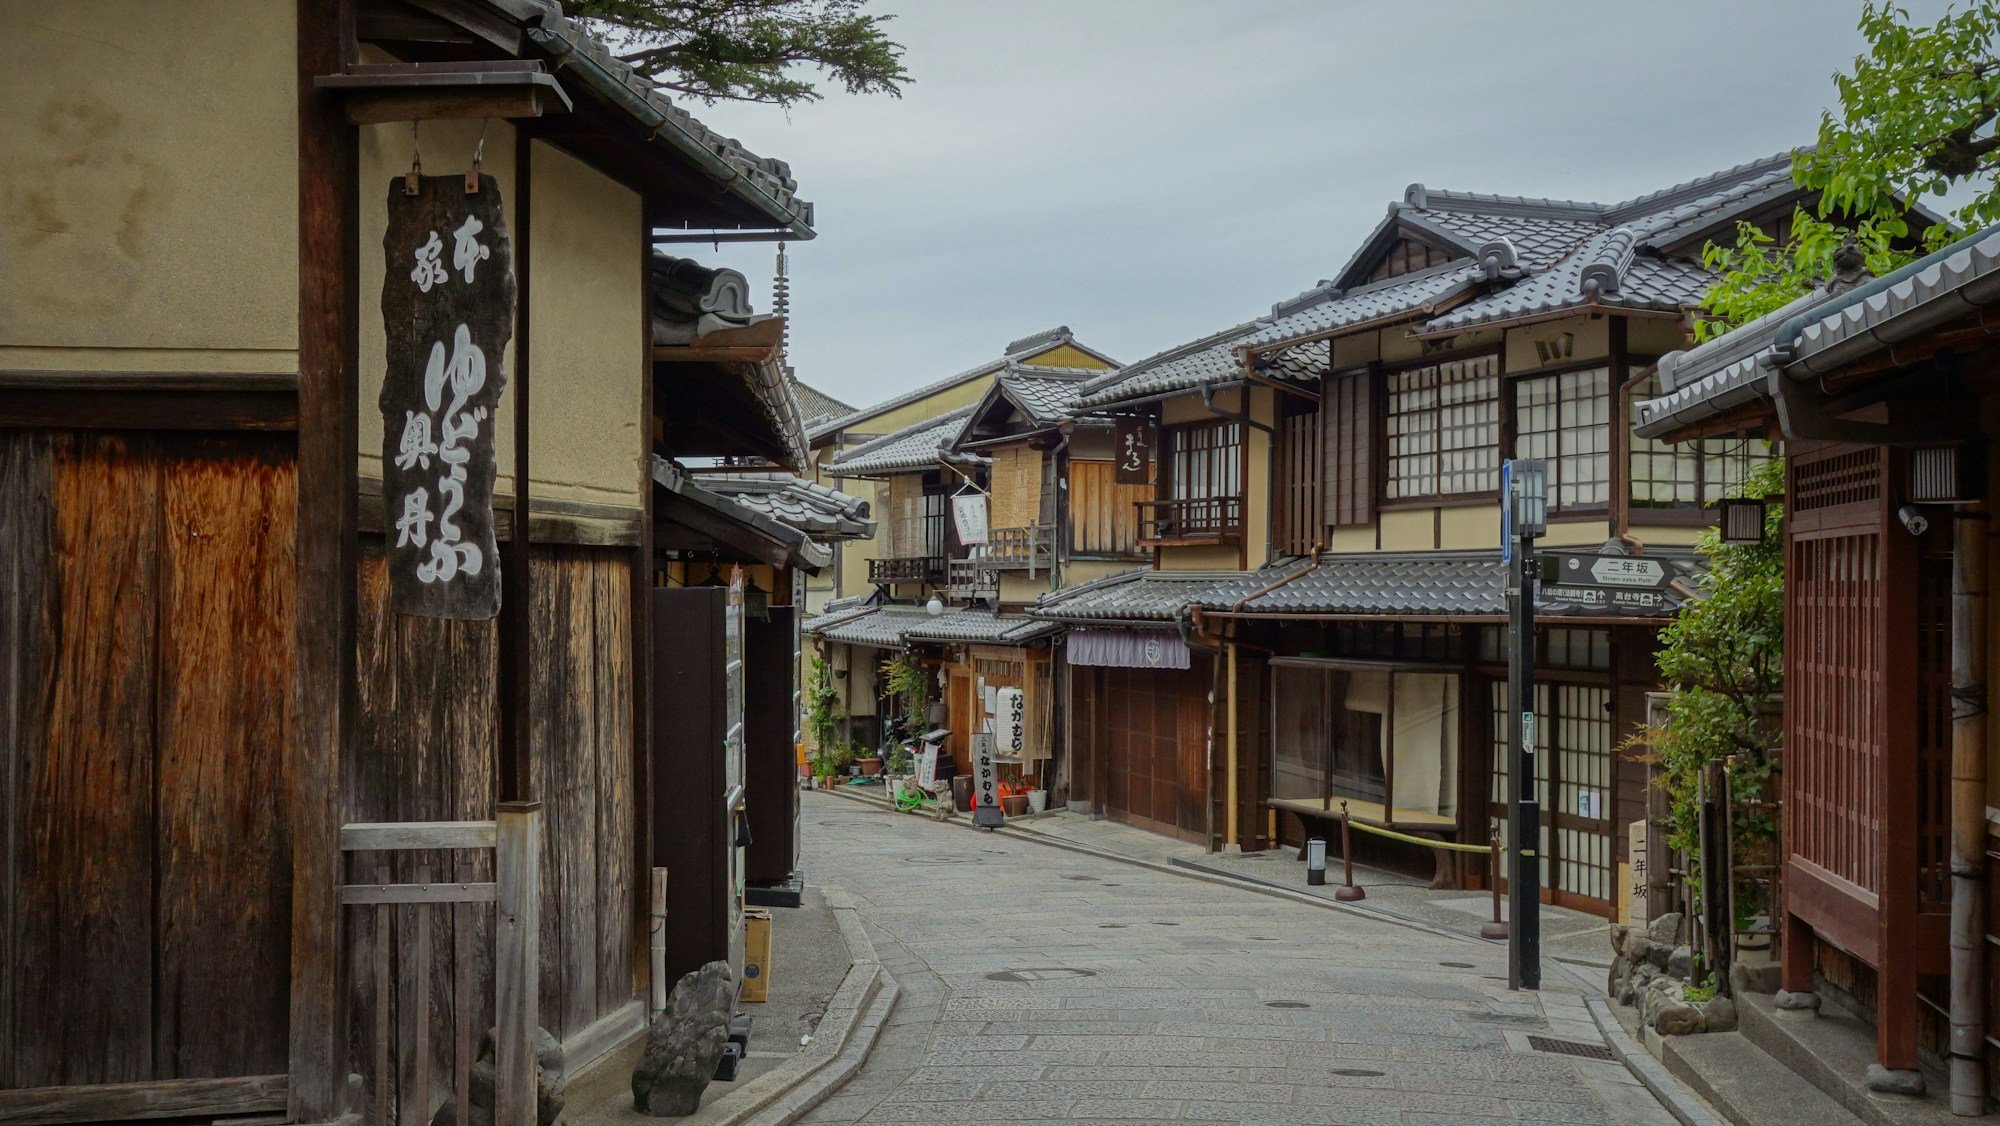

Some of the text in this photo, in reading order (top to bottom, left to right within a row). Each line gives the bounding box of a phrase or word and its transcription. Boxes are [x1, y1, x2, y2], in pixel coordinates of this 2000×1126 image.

[395, 410, 438, 548] 奥丹
[418, 323, 487, 582] ゆどうふ
[1608, 561, 1648, 574] 二年坂
[1616, 592, 1639, 601] 高台寺
[981, 756, 993, 804] なかむら
[1633, 840, 1647, 899] 二年坂
